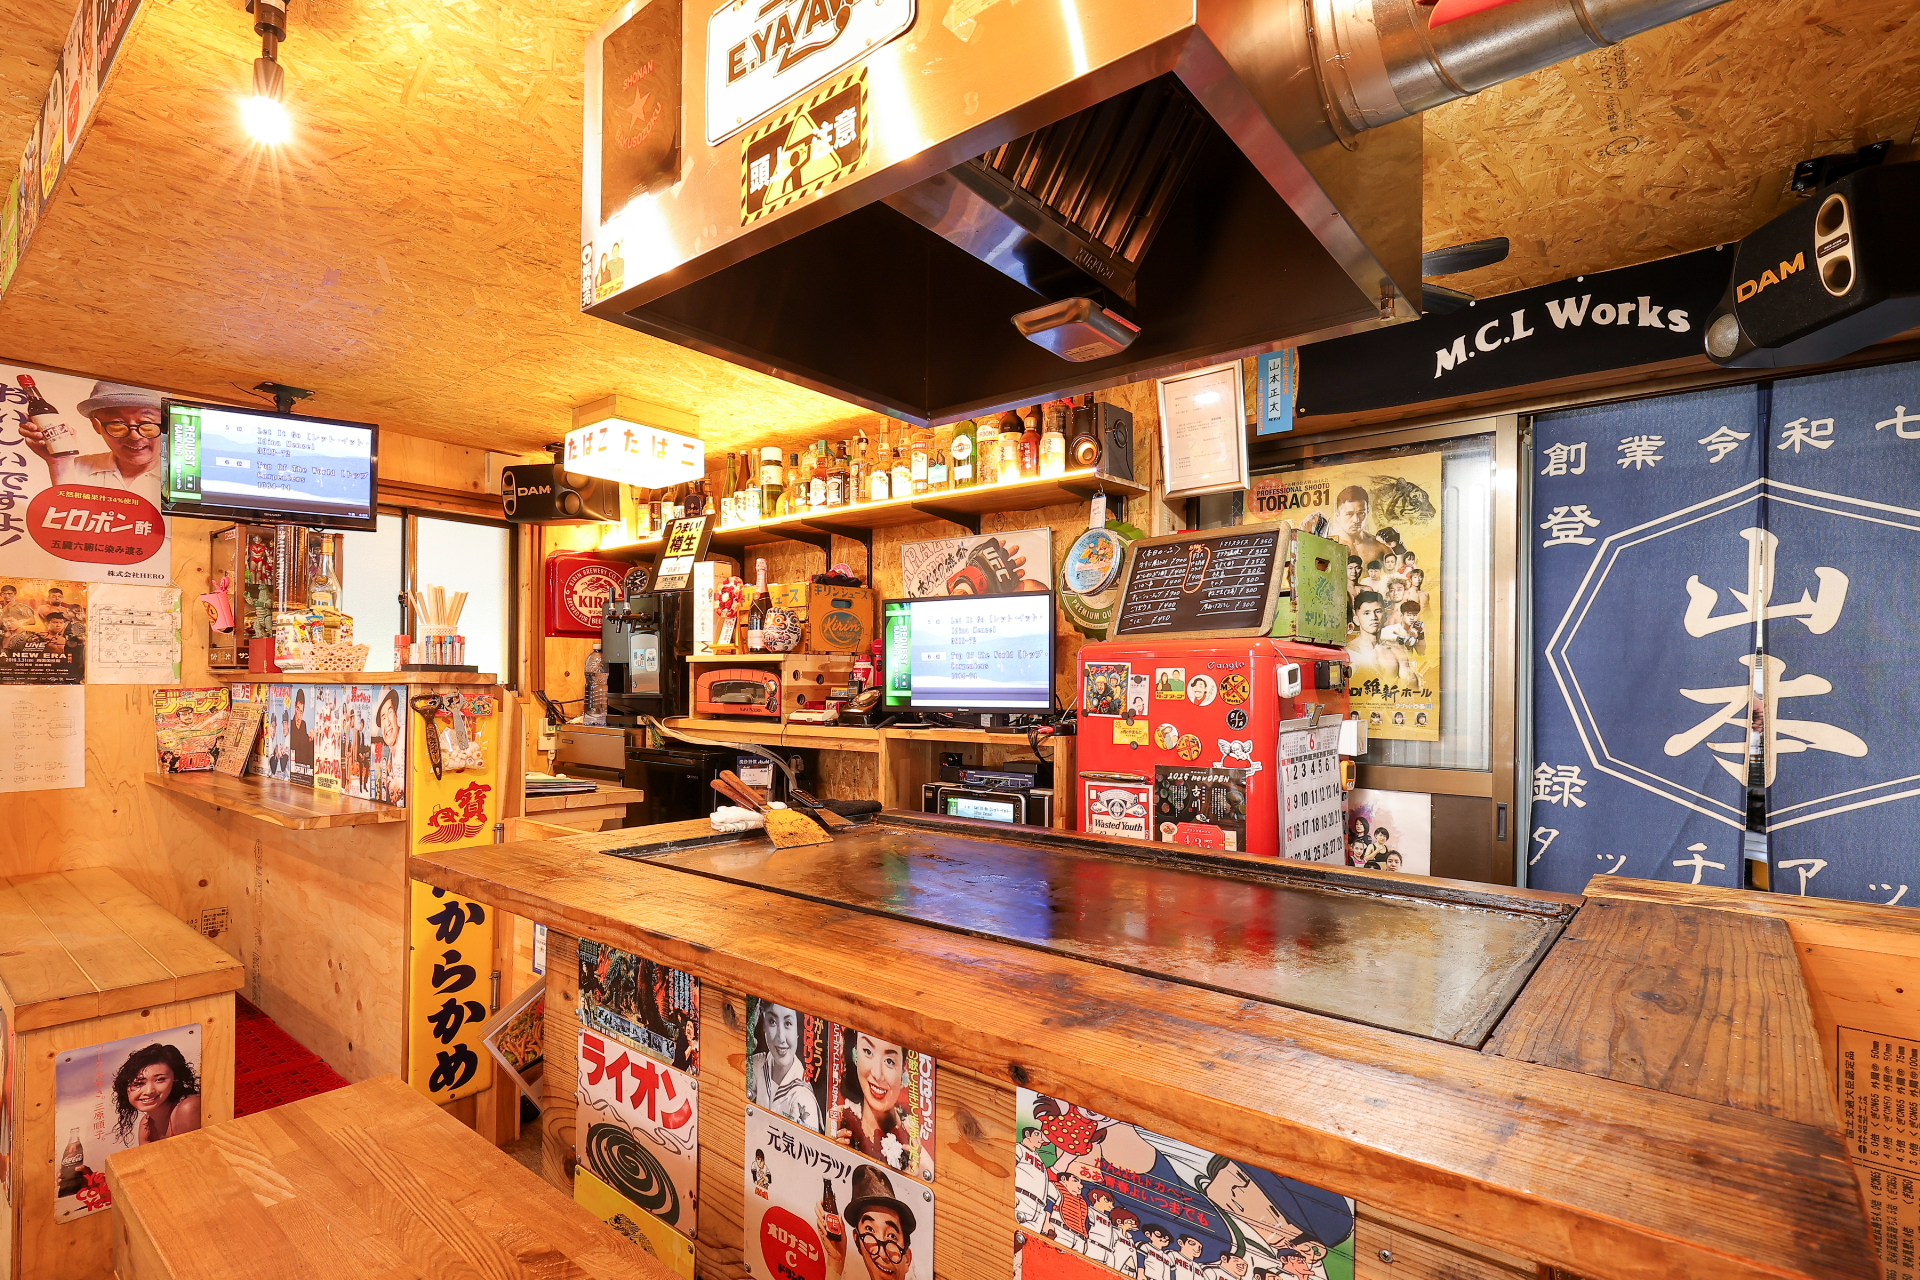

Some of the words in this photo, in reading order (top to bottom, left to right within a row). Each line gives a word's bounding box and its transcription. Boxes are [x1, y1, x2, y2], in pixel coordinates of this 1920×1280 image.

[623, 59, 654, 91] SHONAN
[614, 101, 663, 149] BAKUSOZOKU
[750, 105, 858, 194] 頭上注意
[1737, 252, 1805, 304] DAM
[1433, 308, 1534, 379] M.C.L
[1545, 294, 1692, 334] Works
[1268, 361, 1280, 413] 山本正太
[174, 423, 182, 456] RANKING
[185, 425, 196, 467] REQUEST
[568, 427, 608, 461] たばこ
[624, 429, 695, 466] たばこ
[517, 484, 550, 497] DAM
[1256, 486, 1302, 497] PROFESSIONAL
[1304, 482, 1330, 491] SHOOTO
[41, 506, 153, 537] ヒロポン酢
[675, 520, 702, 535] うまい!
[669, 534, 697, 554] 樽生
[107, 570, 165, 581] 株式会社HERO
[569, 573, 583, 587] KIRIN
[583, 567, 608, 576] BREWERY
[983, 547, 1011, 583] UFC
[578, 595, 604, 609] KIR
[814, 585, 868, 600] キリンジュース
[1071, 598, 1100, 621] PREMIUM
[1305, 610, 1341, 630] キリンレモン
[822, 617, 861, 634] Kirin
[900, 625, 908, 665] REQUEST
[1663, 527, 1869, 788] 山本
[1242, 685, 1248, 693] L
[1349, 678, 1432, 703] DI維新ホール
[1309, 734, 1315, 750] 6
[1286, 766, 1290, 782] 1
[1293, 765, 1298, 780] 2
[1301, 763, 1307, 778] 3
[1310, 761, 1316, 776] 4
[1319, 759, 1323, 774] 5
[1325, 758, 1330, 772] 6
[1332, 756, 1336, 770] 7
[1191, 785, 1202, 812] 古川
[1287, 796, 1291, 812] 8
[1293, 794, 1298, 810] 9
[1301, 791, 1308, 808] 10
[1311, 788, 1318, 805] 11
[1320, 787, 1325, 802] 12
[1326, 784, 1332, 800] 13
[1333, 782, 1340, 798] 14
[1095, 819, 1122, 829] Wasted
[1122, 821, 1143, 832] Youth
[1287, 825, 1292, 842] 15
[1293, 822, 1299, 839] 16
[1302, 820, 1309, 836] 17
[1312, 817, 1319, 833] 18
[1321, 814, 1328, 830] 19
[1328, 811, 1335, 827] 20
[1335, 809, 1341, 824] 21
[1313, 845, 1321, 861] 25
[1322, 842, 1329, 858] 26
[1330, 838, 1336, 855] 27
[1336, 835, 1343, 851] 28
[426, 886, 486, 1094] からかめ
[582, 1033, 693, 1130] ライオン
[1870, 1093, 1880, 1128] くぎCN65
[1896, 1099, 1906, 1135] くぎCN65
[1909, 1102, 1919, 1138] くぎCN65
[766, 1126, 853, 1184] 元気ハツラツ!
[76, 1183, 111, 1201] COK
[83, 1171, 106, 1186] Ye
[1094, 1157, 1194, 1202] がんばれドカベン
[1079, 1166, 1210, 1227] ああ青春よいつまでも
[767, 1222, 819, 1262] オロナミン
[785, 1250, 797, 1268] C
